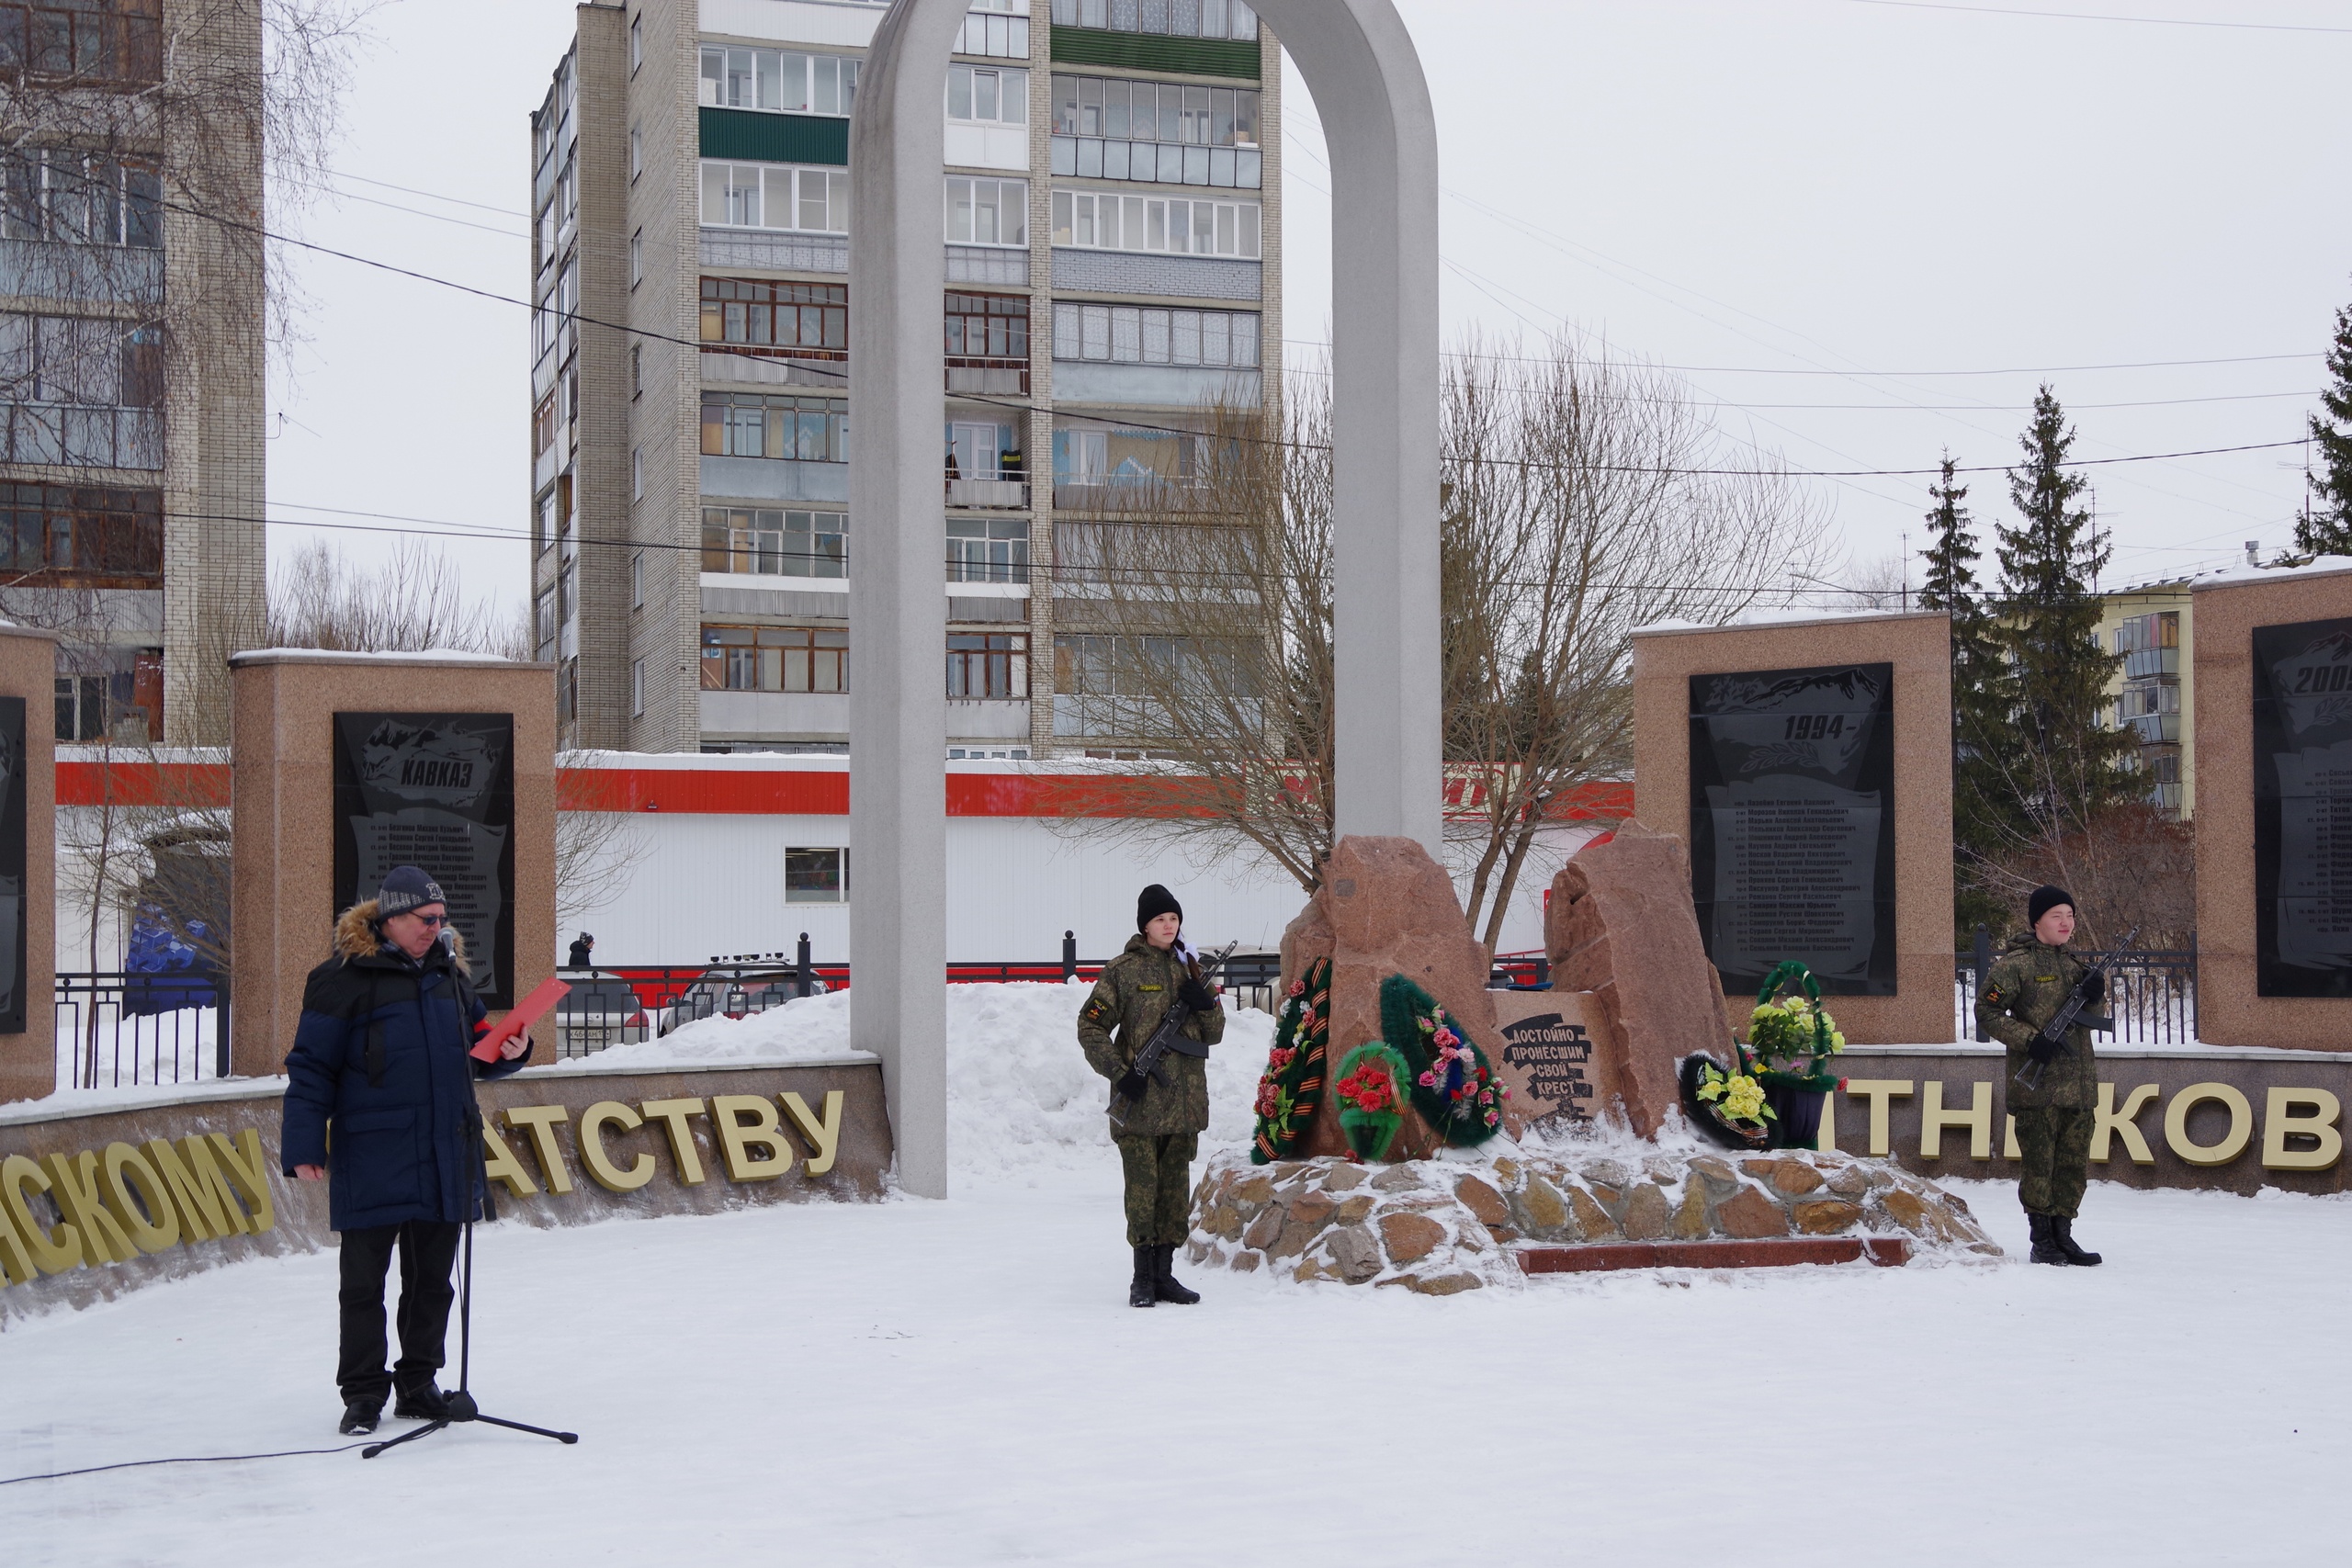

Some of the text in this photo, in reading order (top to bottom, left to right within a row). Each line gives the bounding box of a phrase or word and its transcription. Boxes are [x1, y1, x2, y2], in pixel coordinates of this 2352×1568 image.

[1784, 714, 1857, 740] 1994-
[401, 759, 473, 788] КАВКАЗ
[440, 825, 464, 834] Кузьмич
[415, 834, 434, 842] Сергей
[436, 834, 471, 843] Геннадьевич
[414, 844, 438, 852] Дмитрий
[459, 873, 487, 882] Сергеевич
[1513, 1027, 1574, 1044] ДОСТОЙНО
[1511, 1045, 1585, 1061] ПРОНЁСШИМ
[1536, 1063, 1568, 1078] СВОЙ
[1536, 1081, 1576, 1095] КРЕСТ
[1817, 1078, 2343, 1172] ТНКОВ
[481, 1089, 845, 1196] АТСТВУ
